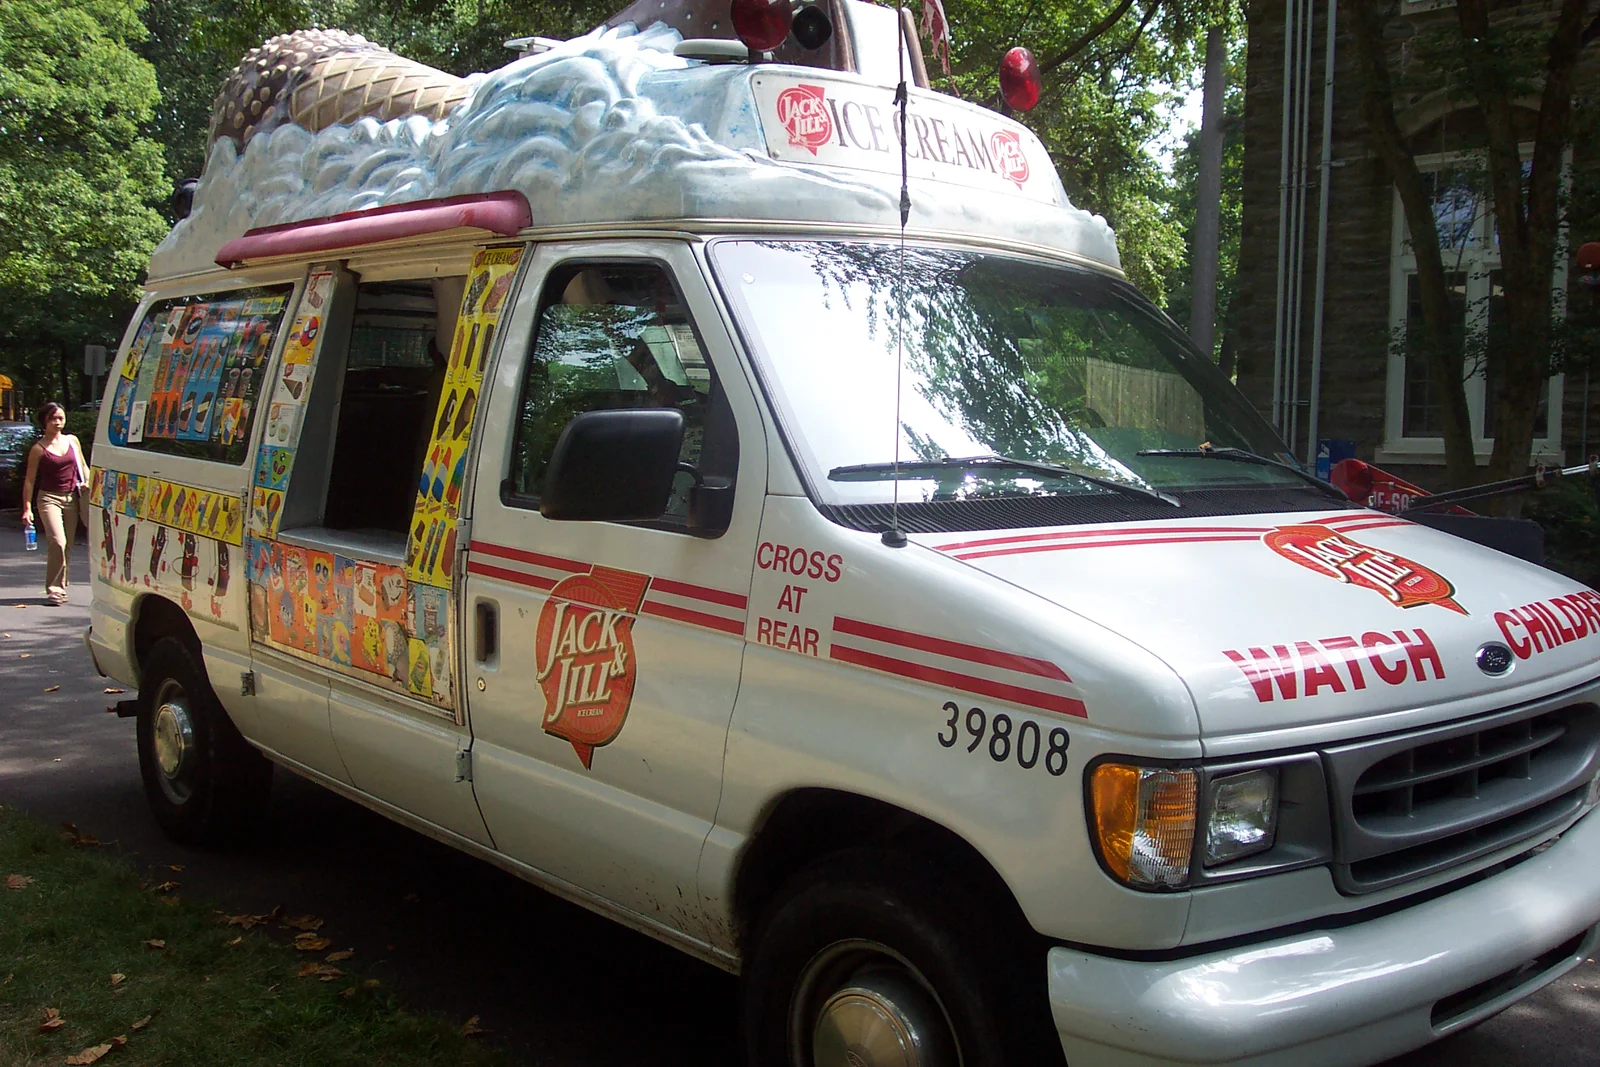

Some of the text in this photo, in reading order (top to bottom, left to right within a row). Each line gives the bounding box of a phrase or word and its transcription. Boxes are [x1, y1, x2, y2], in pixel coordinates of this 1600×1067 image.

[782, 96, 822, 127] JACK
[791, 115, 825, 142] JILL
[826, 98, 998, 174] ICE CREAM
[757, 542, 843, 583] CROSS
[1281, 536, 1361, 583] JACK
[1341, 554, 1414, 601] JILL
[777, 585, 808, 614] AT
[537, 602, 627, 682] JACK &
[757, 617, 820, 657] REAR
[1222, 590, 1600, 703] WATCH CHILDRE
[547, 658, 612, 722] JILL
[937, 701, 1070, 777] 39808
